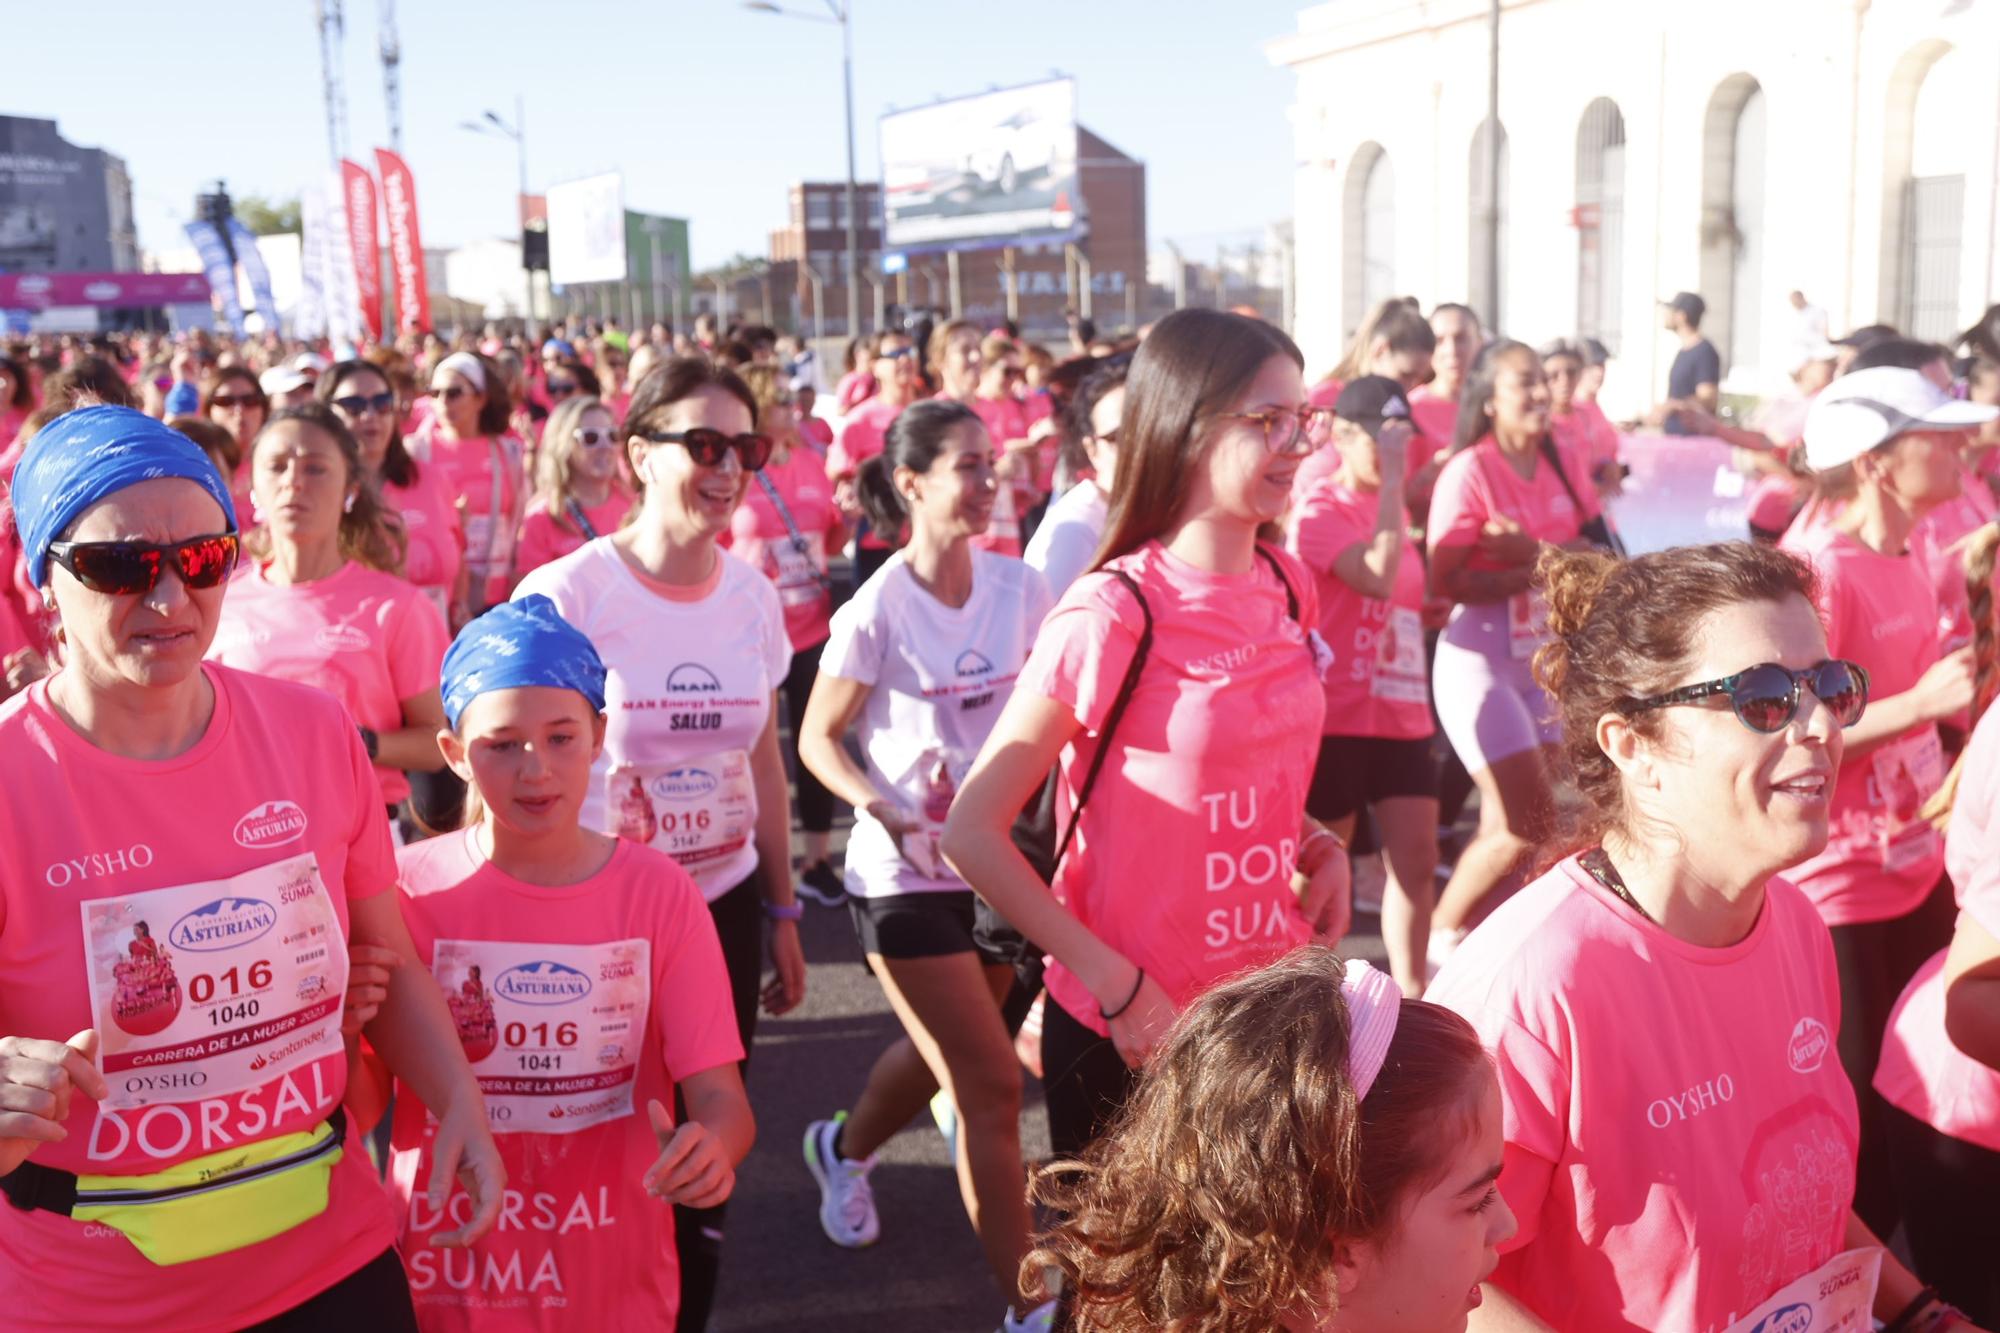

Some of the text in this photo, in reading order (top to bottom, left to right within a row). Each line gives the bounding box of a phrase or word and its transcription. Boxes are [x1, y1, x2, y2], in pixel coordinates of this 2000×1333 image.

[671, 682, 716, 692] MAN
[622, 697, 761, 710] MAN Energy Solutions
[670, 712, 722, 731] SALUD
[661, 809, 711, 832] 016
[1201, 786, 1258, 833] TU
[46, 844, 153, 888] OYSHO
[1205, 838, 1296, 892] DOR
[281, 885, 314, 905] SUMA
[180, 913, 270, 945] ASTURIANA
[189, 959, 272, 1003] 016
[502, 977, 584, 994] ASTURIANA
[600, 966, 634, 981] SUMA
[208, 999, 259, 1026] 1040
[132, 1044, 205, 1066] CARRERA
[208, 1037, 228, 1052] DE
[232, 1030, 251, 1047] LA
[253, 1017, 296, 1041] MUJER
[504, 1021, 578, 1047] 016
[126, 1028, 328, 1094] OYSHO Santander
[518, 1055, 561, 1070] 1041
[479, 1080, 512, 1091] RERA
[515, 1081, 533, 1091] DE
[535, 1081, 552, 1092] LA
[554, 1078, 595, 1091] MUJER
[87, 1062, 333, 1161] DORSAL
[1647, 1072, 1735, 1129] OYSHO
[410, 1248, 564, 1293] SUMA
[1819, 1271, 1861, 1301] SUMA
